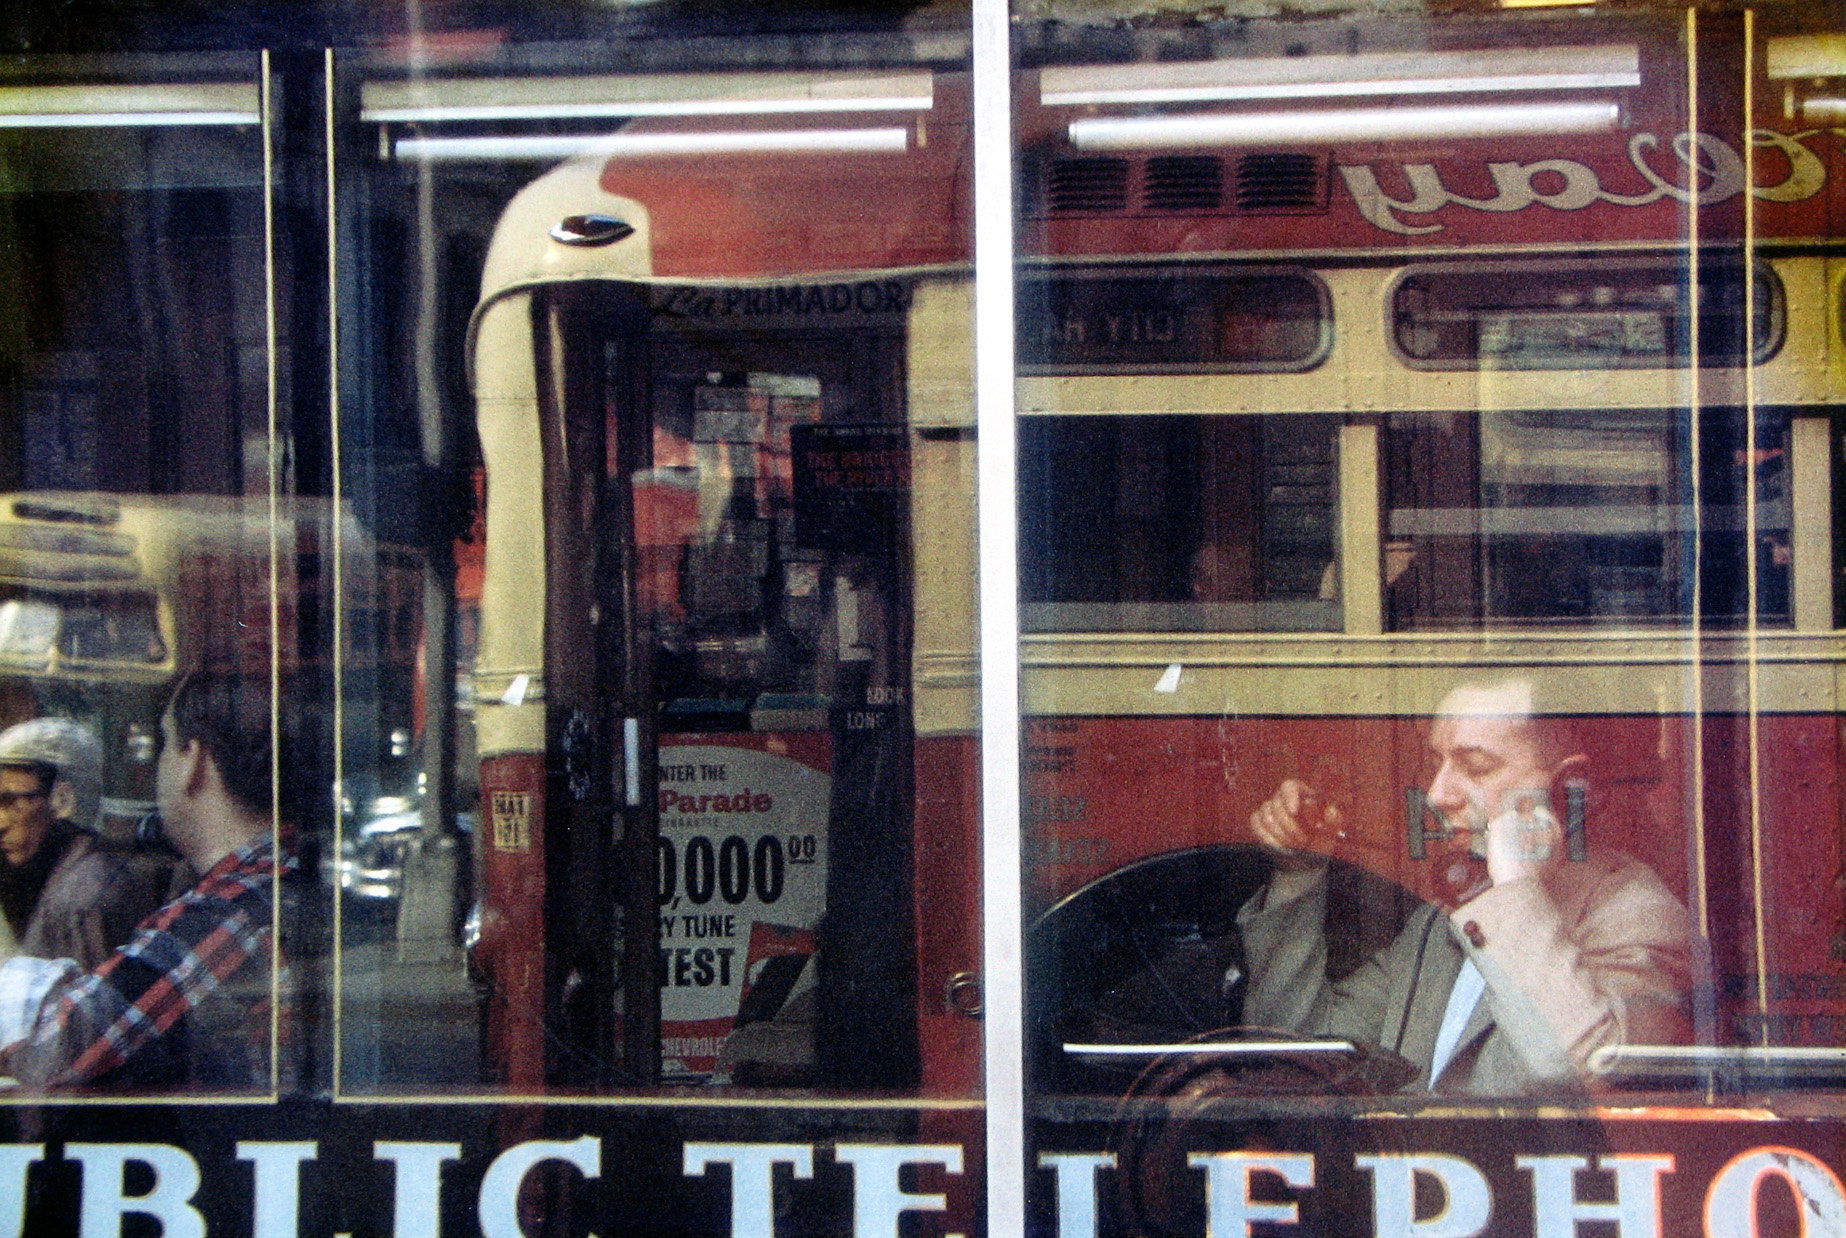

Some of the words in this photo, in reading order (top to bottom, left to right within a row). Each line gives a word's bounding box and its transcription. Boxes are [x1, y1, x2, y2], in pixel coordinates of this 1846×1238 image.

[722, 280, 904, 317] PRIMADOR
[659, 764, 697, 782] NTER
[700, 763, 727, 782] THE
[659, 789, 773, 814] Parade
[683, 914, 736, 938] TUNE
[660, 1036, 728, 1057] CHEVROLE
